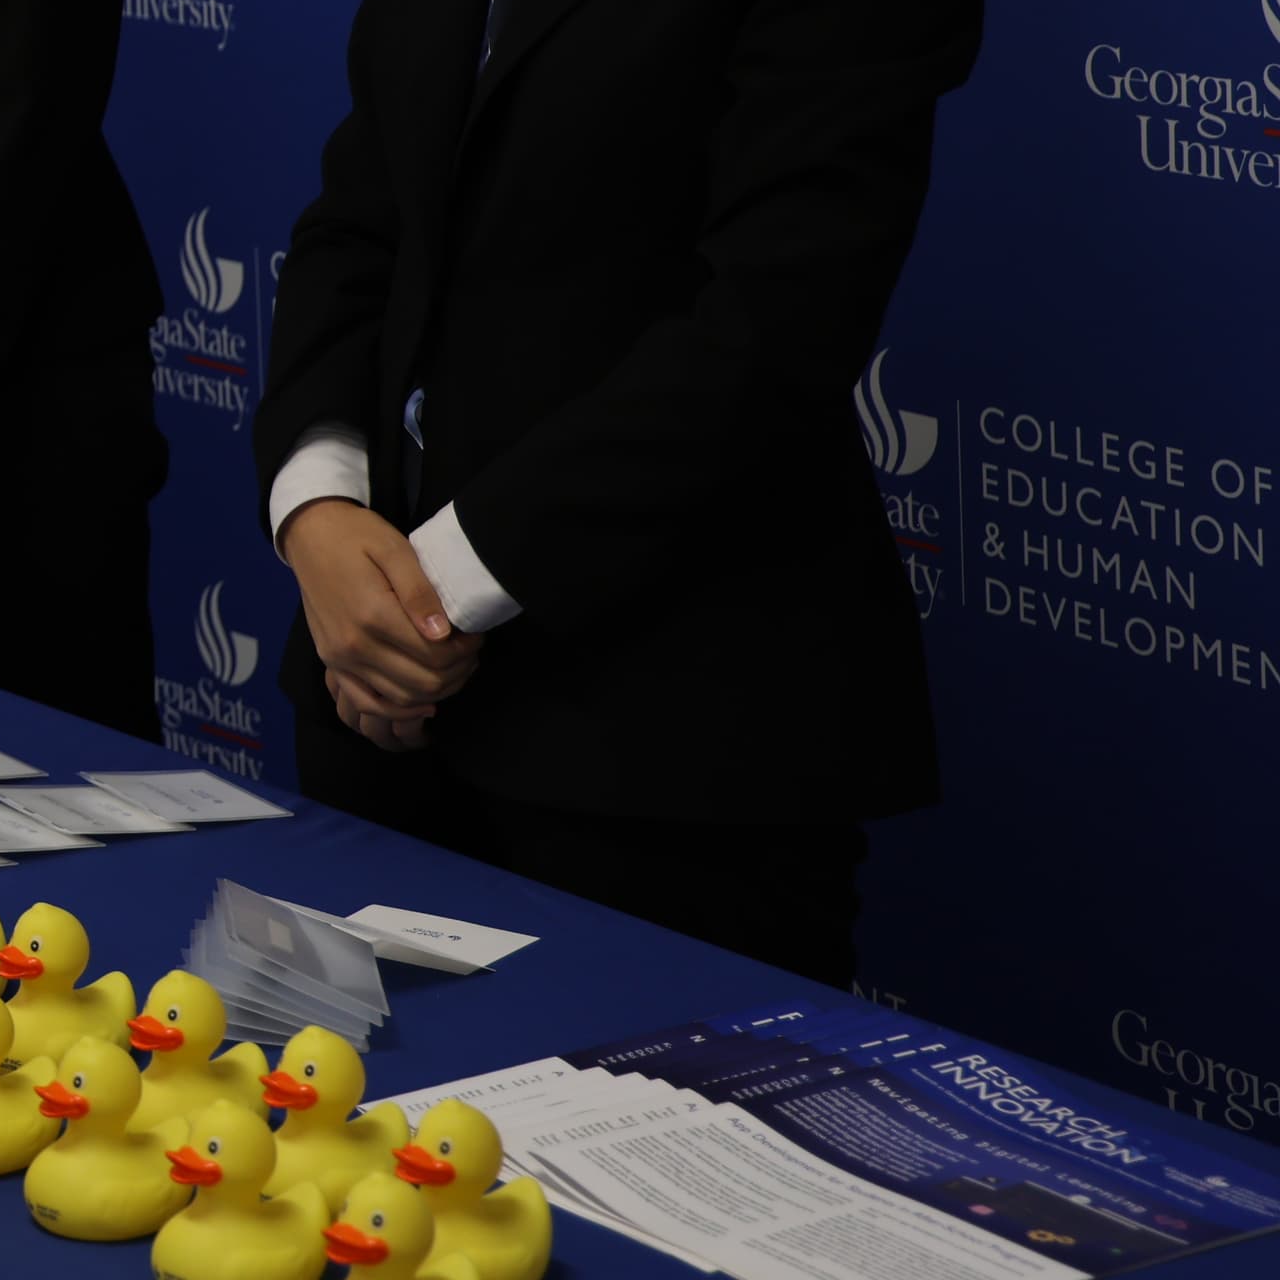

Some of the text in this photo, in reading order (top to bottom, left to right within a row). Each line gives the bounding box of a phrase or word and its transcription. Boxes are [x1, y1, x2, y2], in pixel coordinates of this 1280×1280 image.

[1085, 44, 1280, 140] Georgia
[1136, 114, 1280, 189] Unive
[979, 406, 1272, 505] COLLEGE OF
[982, 461, 1264, 567] EDUCATION
[982, 522, 1196, 610] & HUMAN
[985, 576, 1280, 690] DEVELOPMEN
[153, 676, 262, 737] rgiaState
[868, 1077, 969, 1141] Navigating
[930, 1060, 1148, 1165] INNOVATION
[957, 1054, 1128, 1138] RESEARCH
[1111, 1009, 1280, 1131] Georgia
